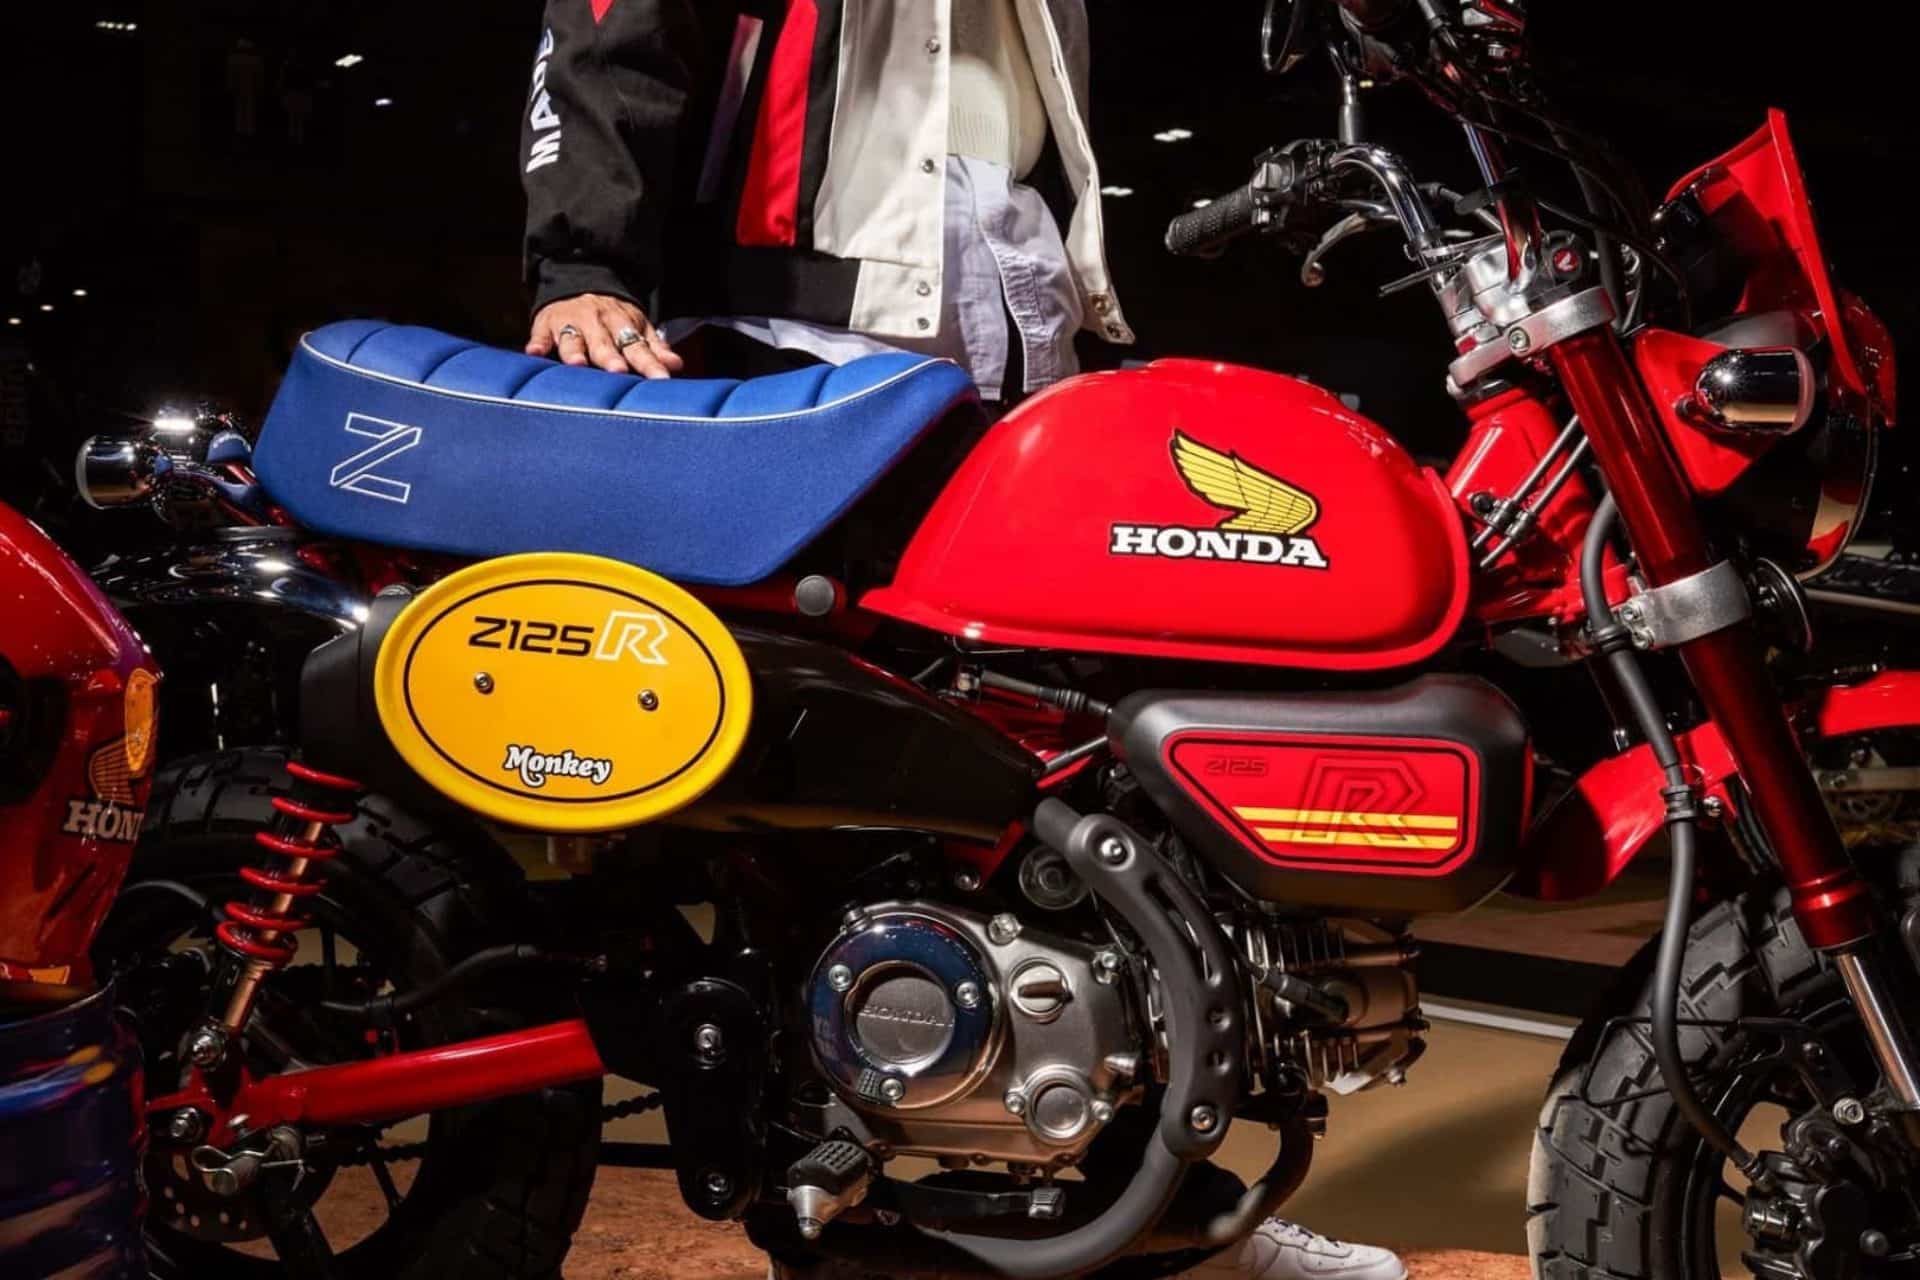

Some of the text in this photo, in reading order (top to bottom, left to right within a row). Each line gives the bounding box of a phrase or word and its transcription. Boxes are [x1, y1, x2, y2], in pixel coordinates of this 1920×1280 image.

[329, 411, 422, 504] Z
[1110, 524, 1329, 570] HONDA
[502, 744, 613, 788] Monkey
